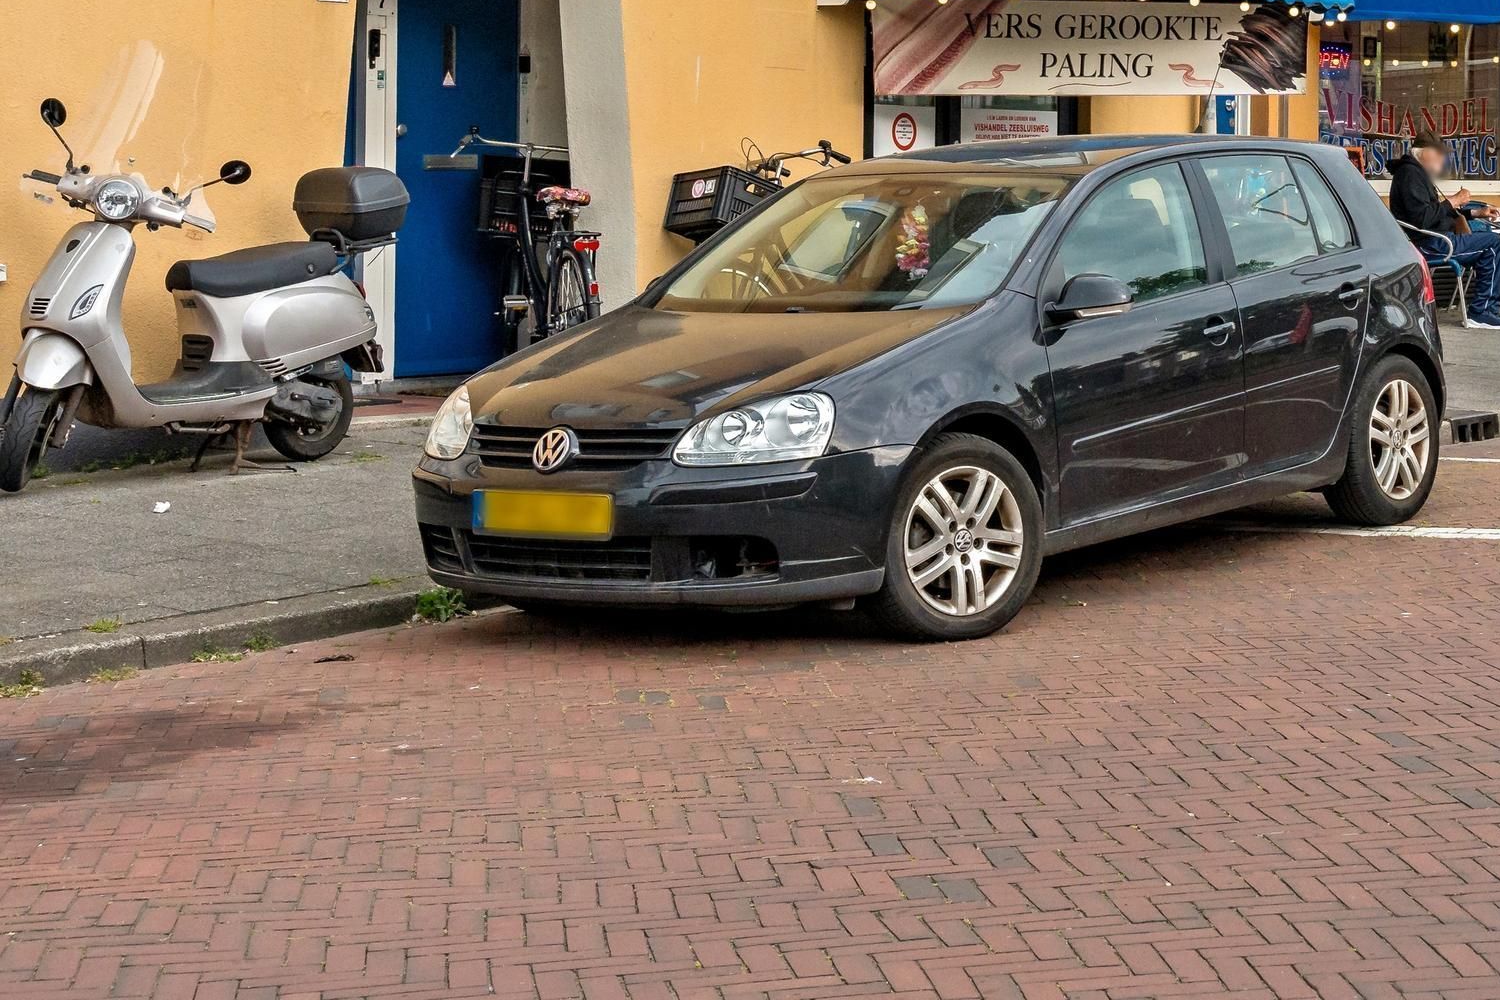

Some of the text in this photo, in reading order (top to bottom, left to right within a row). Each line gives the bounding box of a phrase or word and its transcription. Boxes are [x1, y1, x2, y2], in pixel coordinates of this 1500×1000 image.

[964, 12, 1223, 41] VERS GEROOKTE
[1039, 52, 1154, 79] PALING
[1321, 87, 1496, 139] VISHANDEL
[974, 123, 1049, 133] VISHANDEL ZEESLUISWEG
